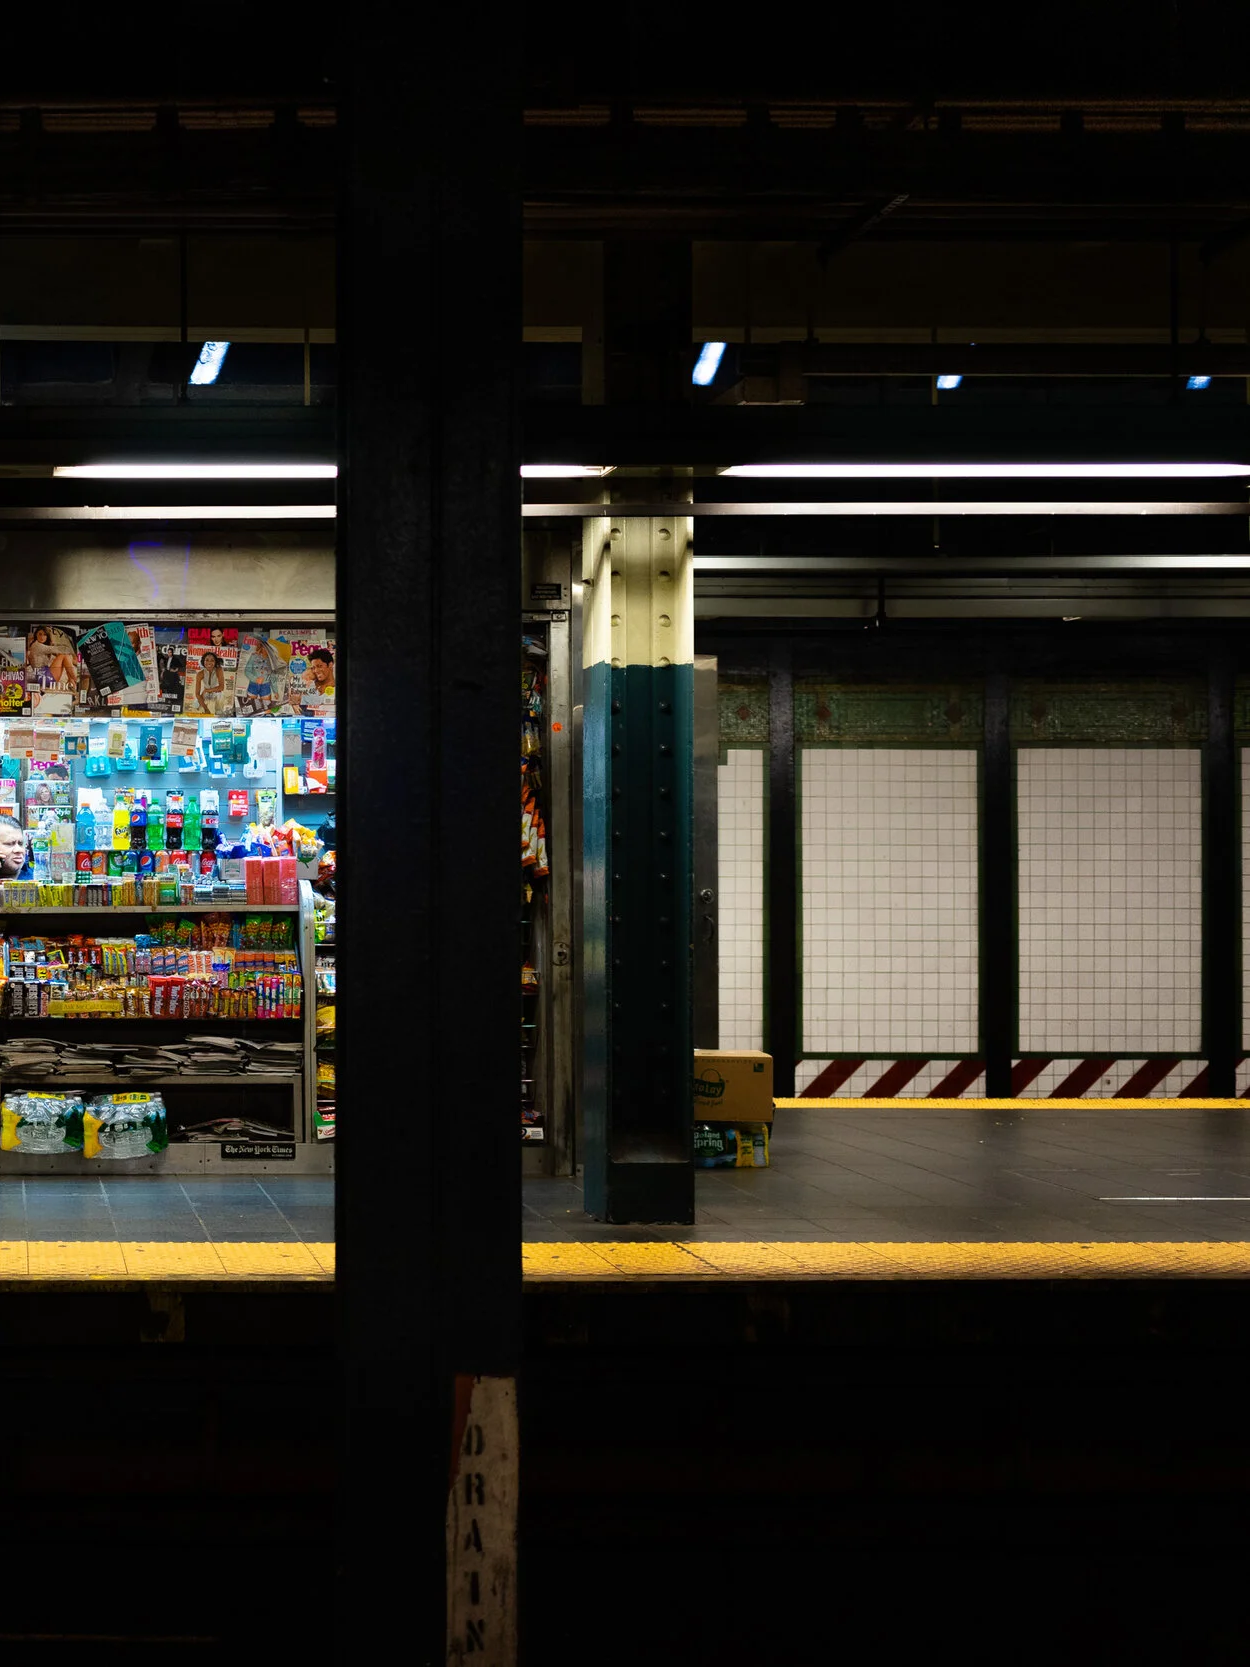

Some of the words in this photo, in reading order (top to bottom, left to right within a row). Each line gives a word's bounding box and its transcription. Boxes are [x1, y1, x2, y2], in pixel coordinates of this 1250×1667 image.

[216, 647, 238, 658] Health
[1, 671, 25, 681] CHIVAS
[225, 1144, 239, 1154] The
[240, 1145, 254, 1154] New
[254, 1144, 271, 1155] York
[271, 1144, 293, 1154] Times
[463, 1424, 487, 1652] DRAIN
